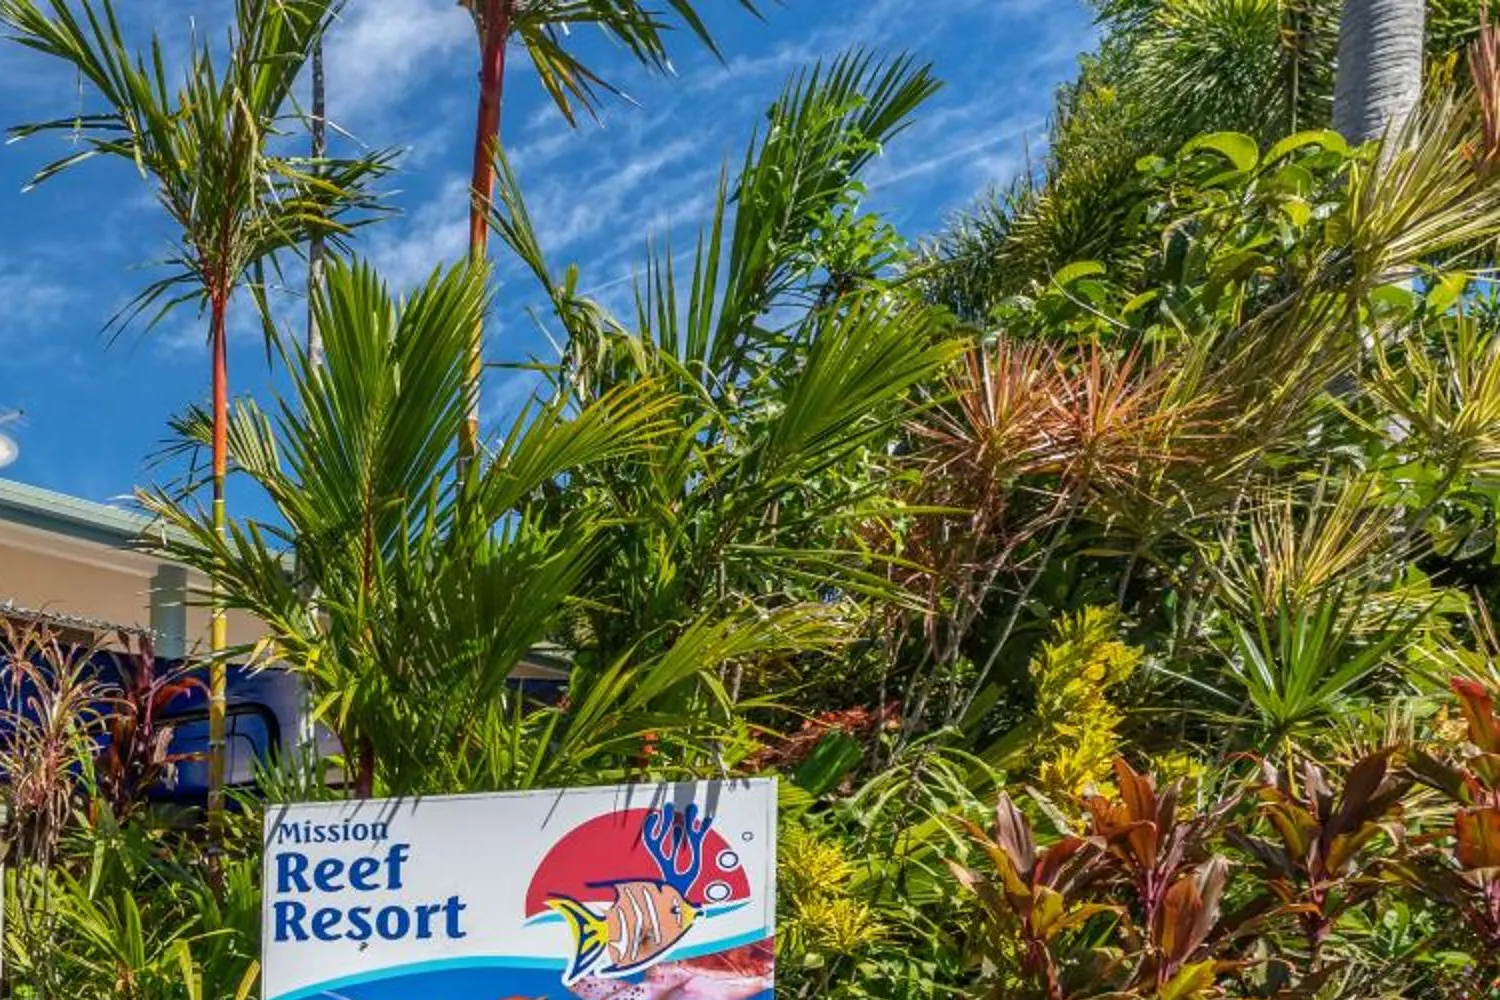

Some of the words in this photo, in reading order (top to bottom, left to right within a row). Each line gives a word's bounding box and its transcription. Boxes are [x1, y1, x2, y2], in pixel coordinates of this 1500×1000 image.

[277, 819, 389, 845] Mission
[275, 844, 410, 893] Reef
[274, 895, 467, 943] Resort
